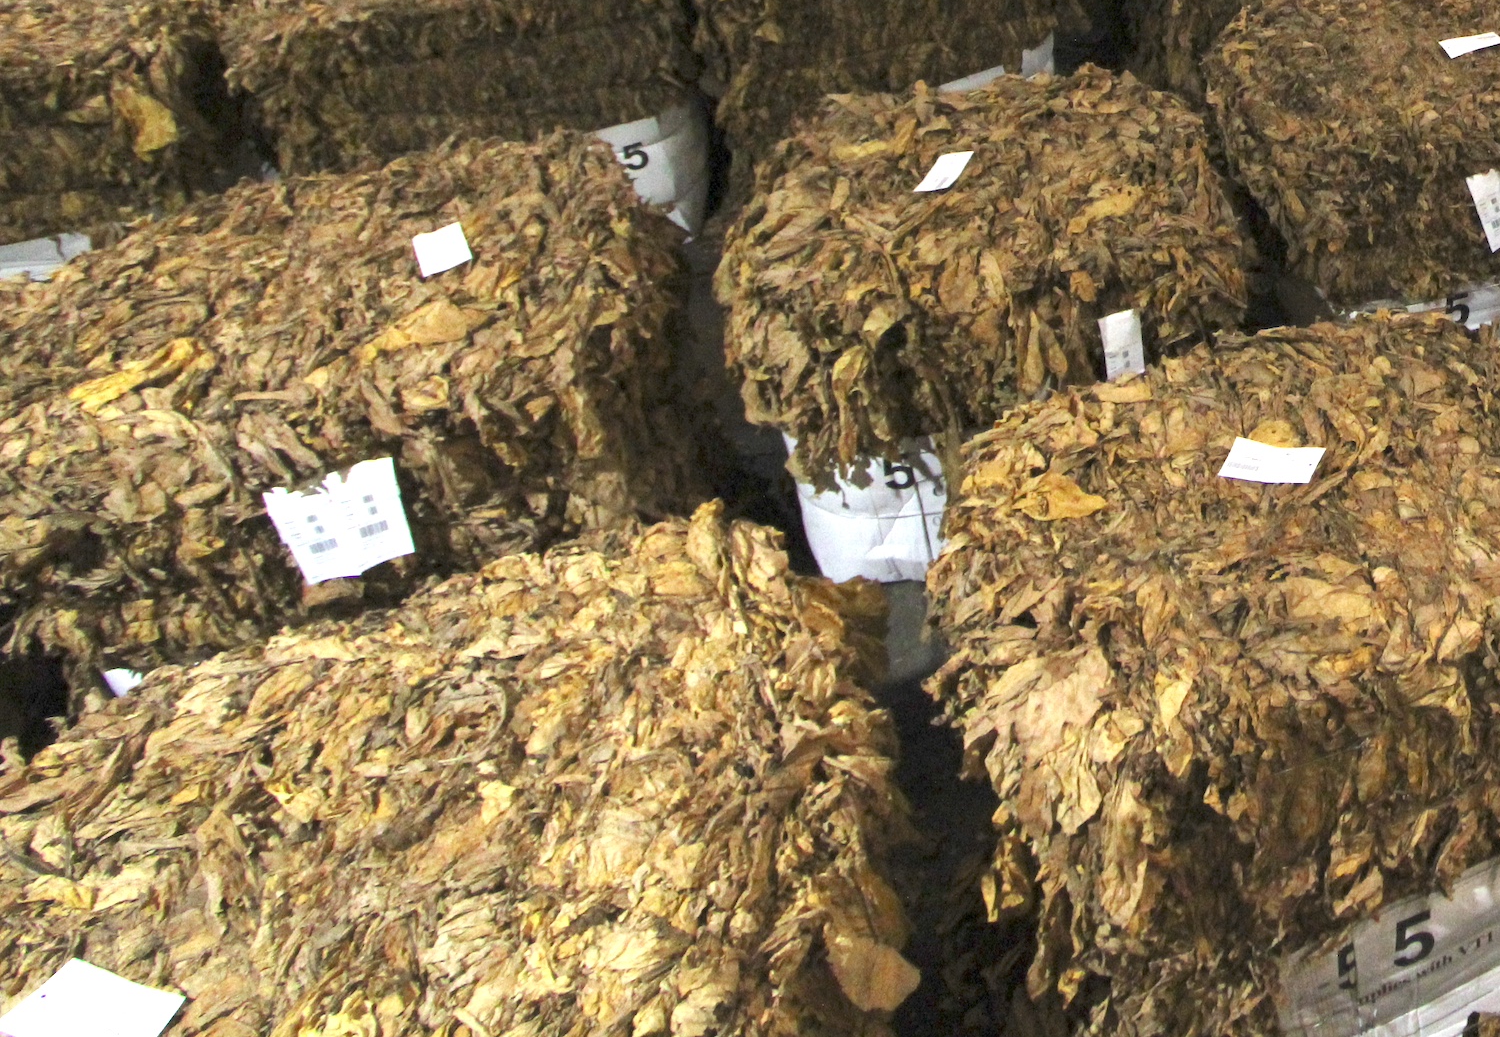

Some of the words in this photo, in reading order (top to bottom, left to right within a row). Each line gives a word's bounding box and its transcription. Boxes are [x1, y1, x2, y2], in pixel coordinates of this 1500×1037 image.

[623, 142, 649, 170] 5
[1446, 292, 1470, 323] 5
[1394, 909, 1435, 967] 5
